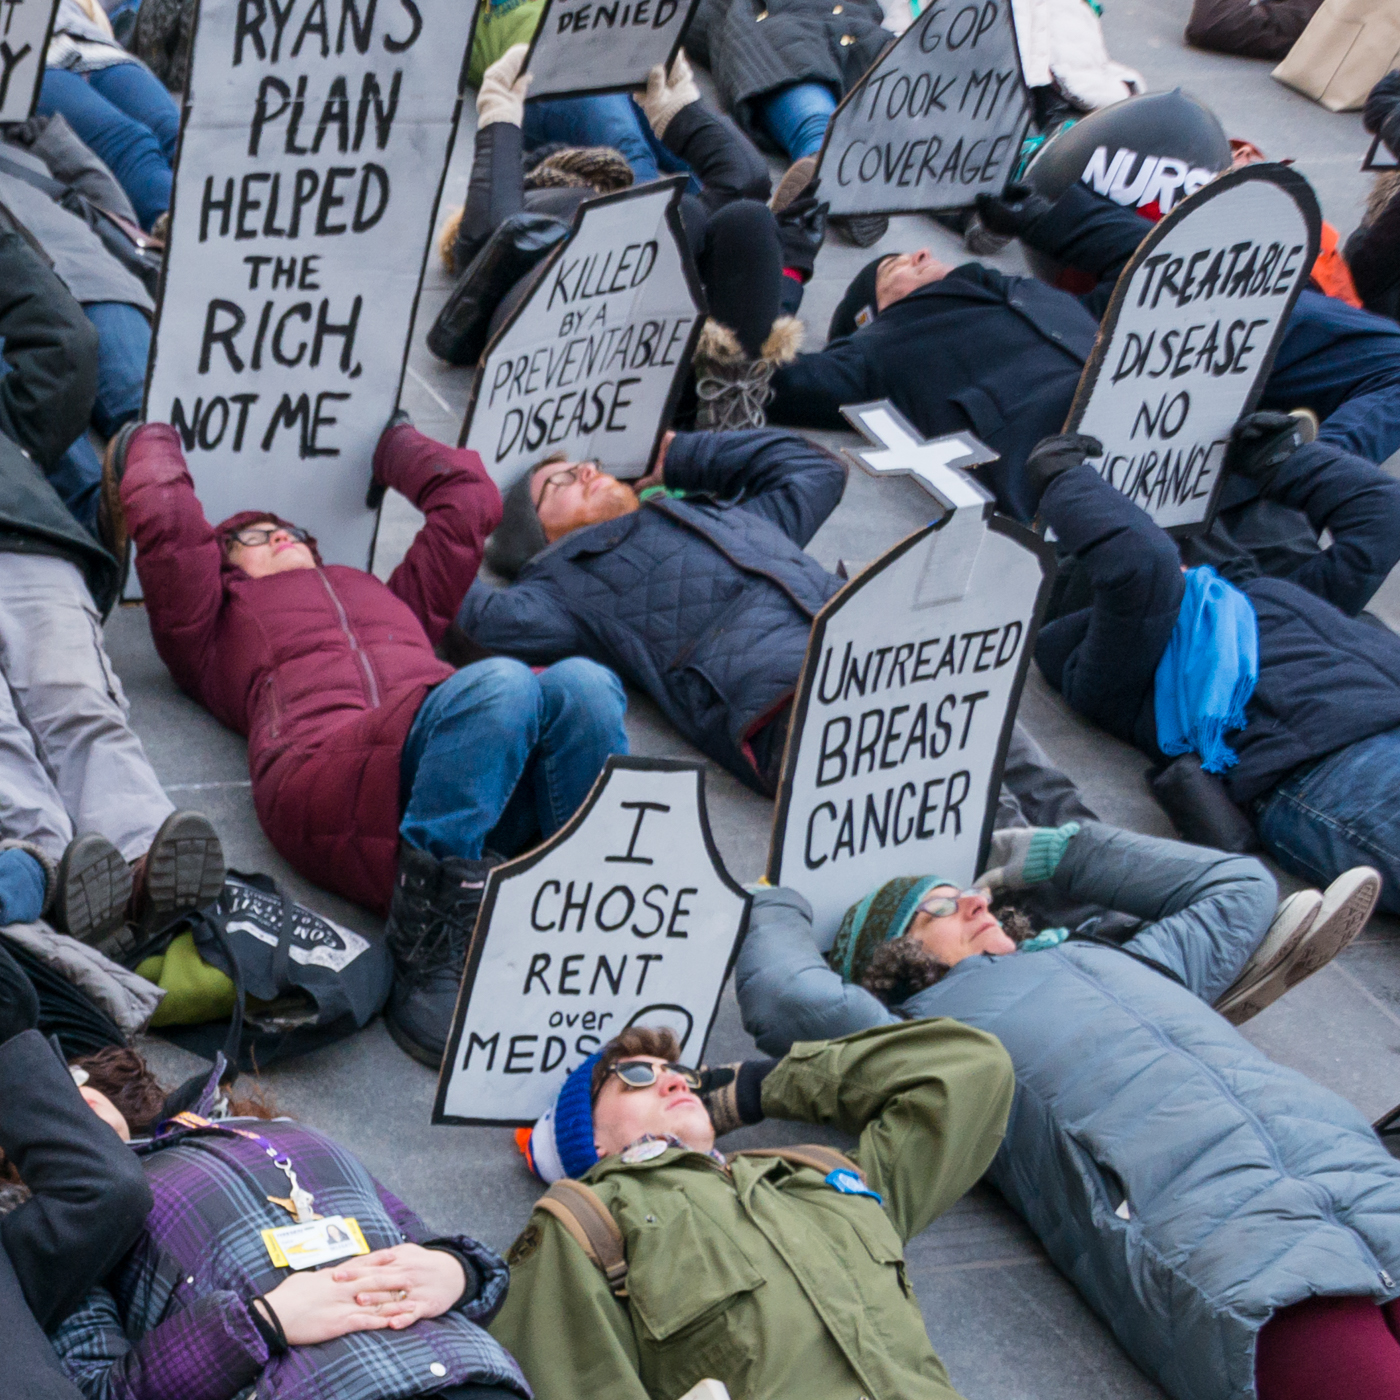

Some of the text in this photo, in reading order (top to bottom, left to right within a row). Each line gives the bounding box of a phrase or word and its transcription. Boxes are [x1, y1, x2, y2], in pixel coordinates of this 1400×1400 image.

[557, 0, 678, 34] DENIED
[919, 4, 997, 54] GOP
[248, 69, 403, 157] PLAN
[867, 68, 1016, 121] TOOK MY
[836, 135, 1008, 188] COVERAGE
[199, 163, 391, 243] HELPED
[244, 254, 324, 292] THE
[547, 240, 658, 311] KILLED
[1136, 241, 1304, 309] TREATABLE
[198, 294, 363, 379] RICH,
[558, 303, 607, 338] BY A
[1111, 318, 1269, 387] DISEASE
[488, 318, 691, 409] PREVENTABLE
[172, 391, 352, 460] NOT ME
[496, 378, 641, 462] DISEASE
[1130, 390, 1190, 441] NO
[816, 620, 1022, 706] UNTREATED
[815, 690, 989, 788] BREAST
[605, 801, 670, 865] I
[804, 769, 970, 870] CANCER
[531, 880, 698, 939] CHOSE
[523, 953, 662, 996] RENT
[548, 1010, 613, 1031] over
